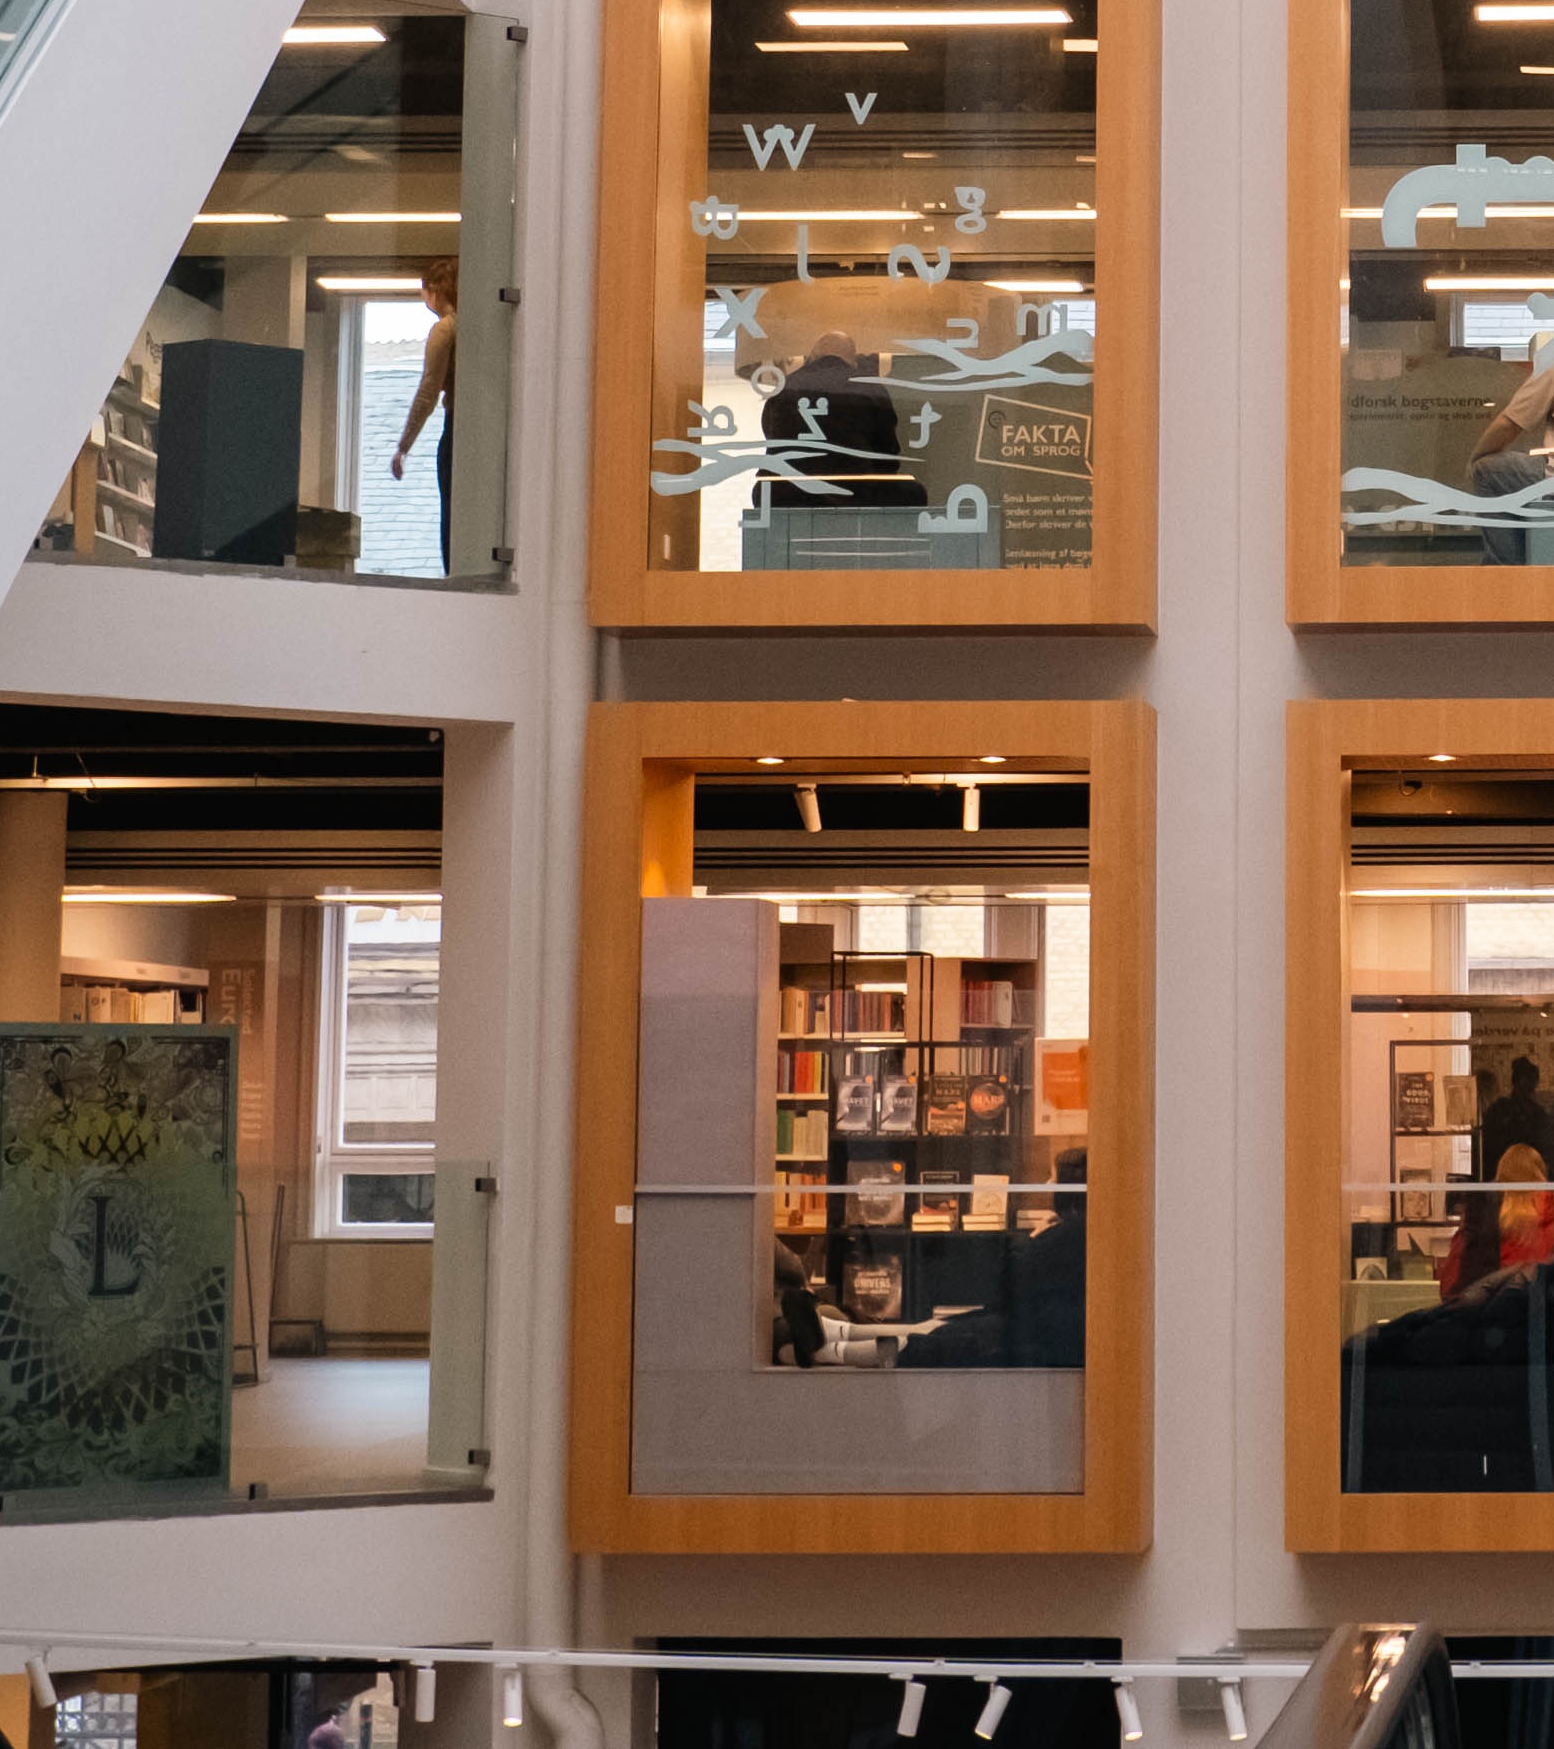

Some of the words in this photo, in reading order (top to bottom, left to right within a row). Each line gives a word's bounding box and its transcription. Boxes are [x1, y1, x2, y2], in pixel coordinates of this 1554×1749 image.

[1346, 394, 1397, 408] dforsk
[1001, 424, 1081, 444] FAKTA
[1000, 445, 1025, 457] OM
[1032, 445, 1081, 457] SPROG
